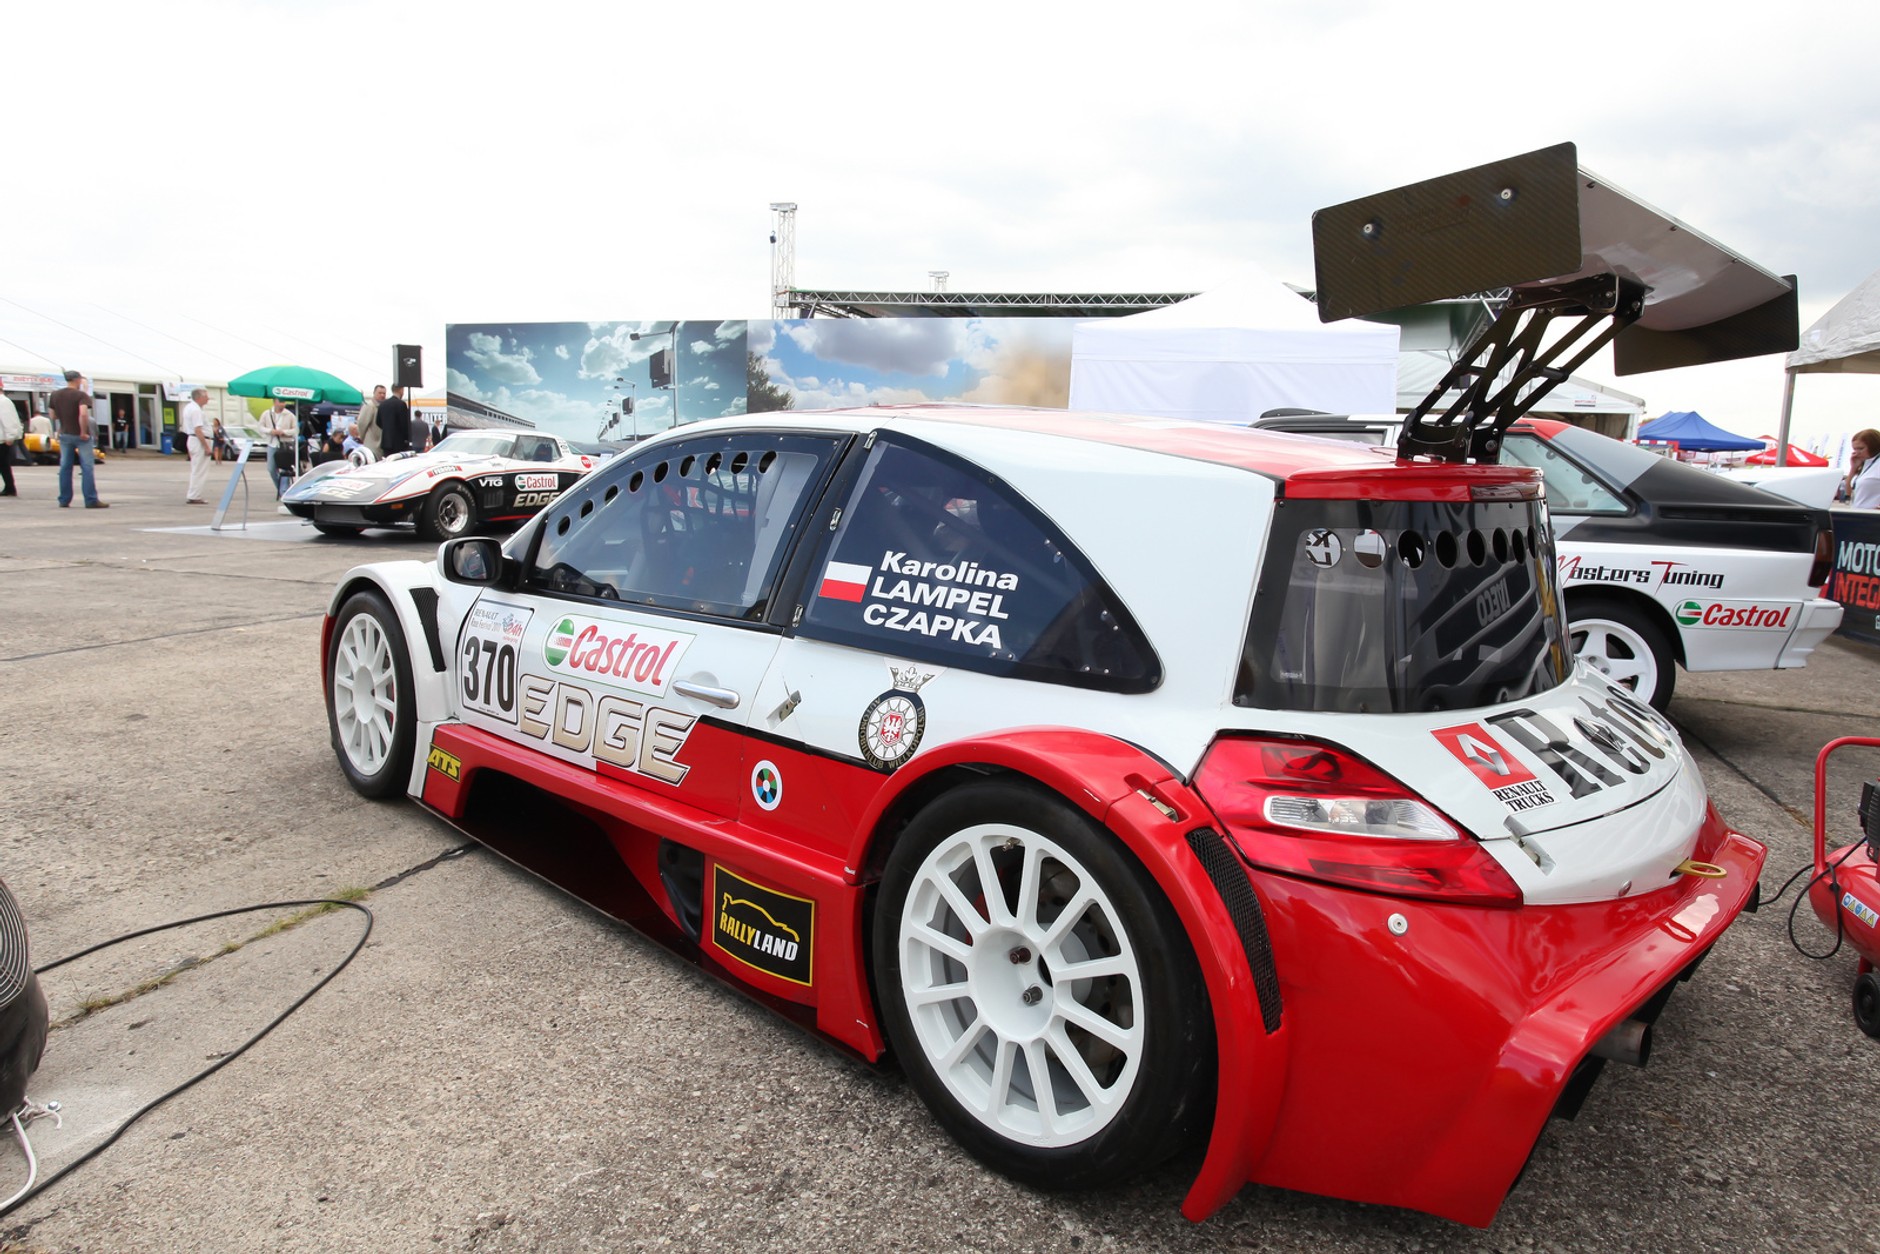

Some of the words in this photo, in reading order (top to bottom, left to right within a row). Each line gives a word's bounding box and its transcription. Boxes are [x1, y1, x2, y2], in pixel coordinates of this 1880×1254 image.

[281, 388, 309, 398] Castrol
[478, 478, 503, 487] VTG
[526, 476, 557, 489] Castrol
[880, 550, 1020, 592] Karolina
[1557, 555, 1650, 587] Masters
[1651, 560, 1724, 597] Tuning
[871, 576, 1009, 620] LAMPEL
[1703, 603, 1792, 628] Castrol
[863, 603, 1002, 649] CZAPKA
[463, 635, 516, 713] 370
[569, 624, 679, 687] Castrol
[520, 673, 698, 785] EDGE
[859, 697, 884, 770] AUTOMOBILKLUB
[427, 748, 462, 778] ATS
[1492, 780, 1548, 801] RENAULT
[1505, 791, 1555, 812] TRUCKS
[719, 911, 799, 962] RALLYLAND
